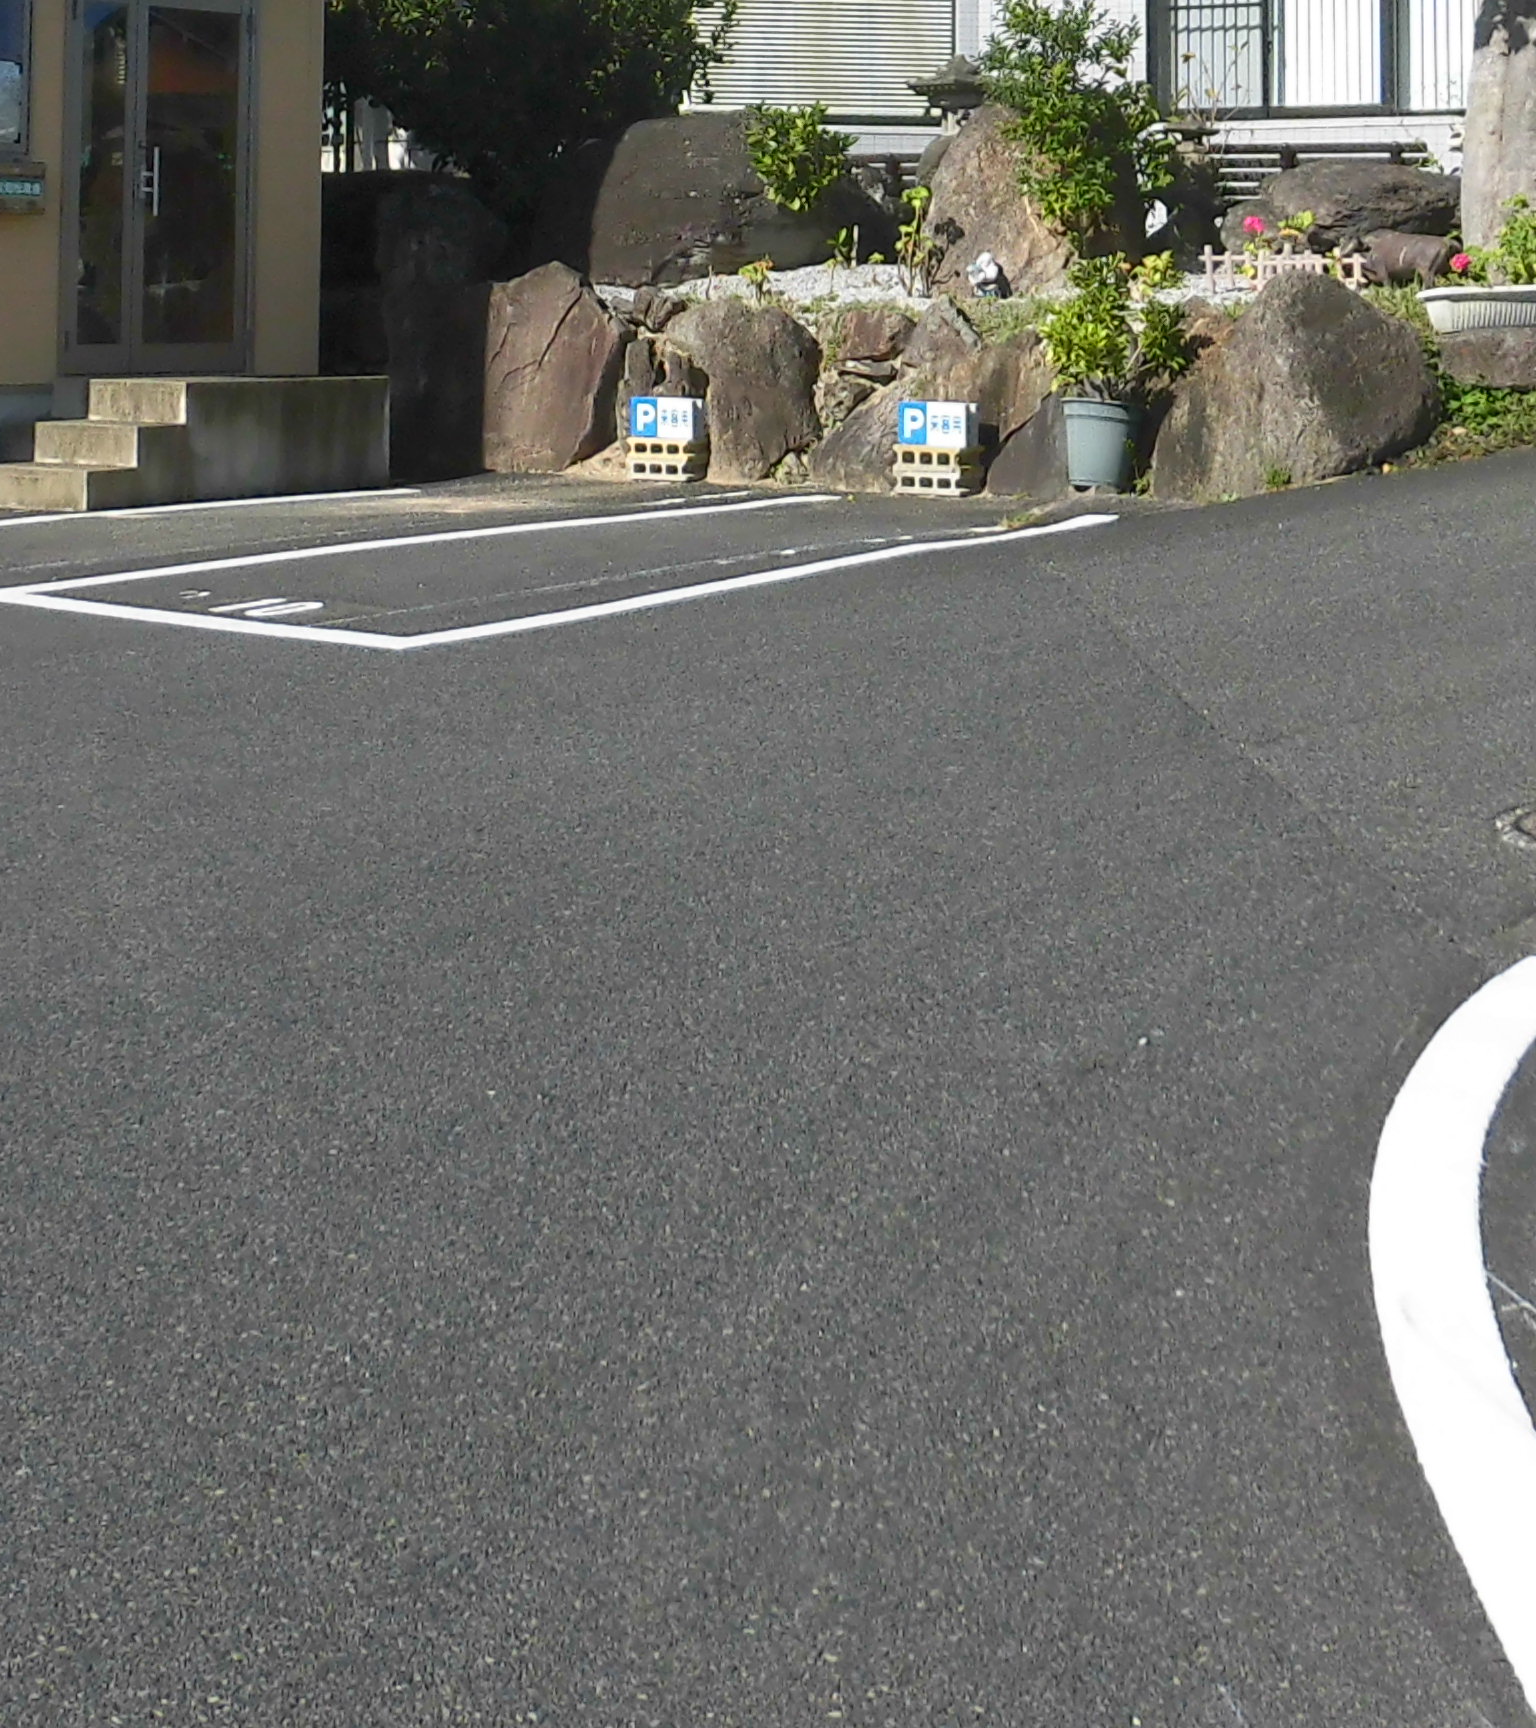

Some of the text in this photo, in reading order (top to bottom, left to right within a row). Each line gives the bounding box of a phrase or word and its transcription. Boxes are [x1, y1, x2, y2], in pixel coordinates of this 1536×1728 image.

[636, 402, 655, 432] P
[903, 407, 924, 439] P
[207, 597, 325, 618] 10
